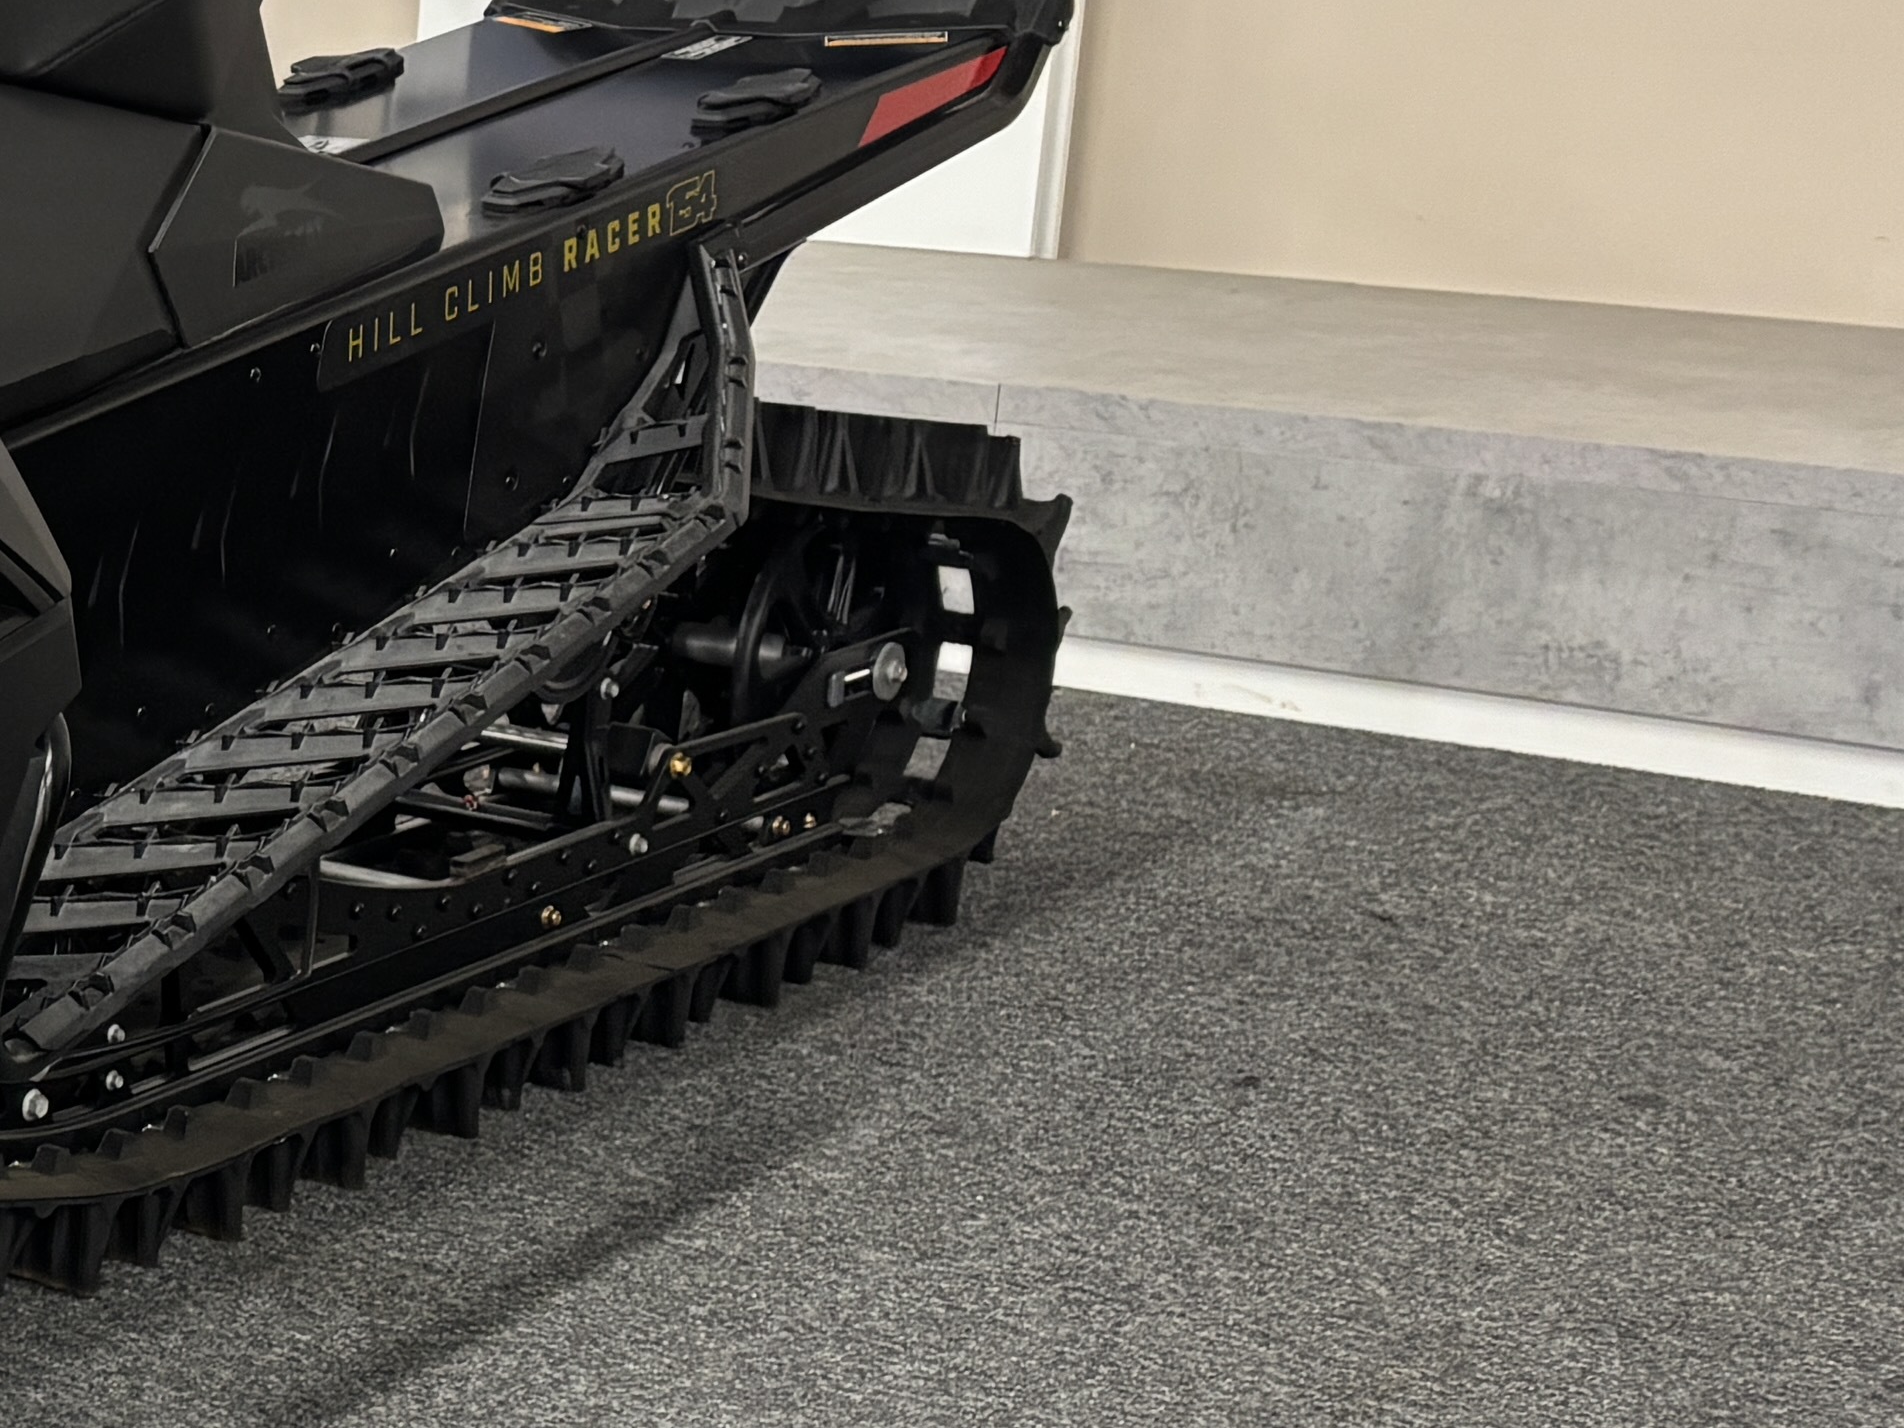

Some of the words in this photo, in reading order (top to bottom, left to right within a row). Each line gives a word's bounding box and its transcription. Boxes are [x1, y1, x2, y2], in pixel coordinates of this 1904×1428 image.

[348, 302, 423, 363] HILL
[445, 251, 543, 323] CLIMB
[563, 202, 662, 273] RACER
